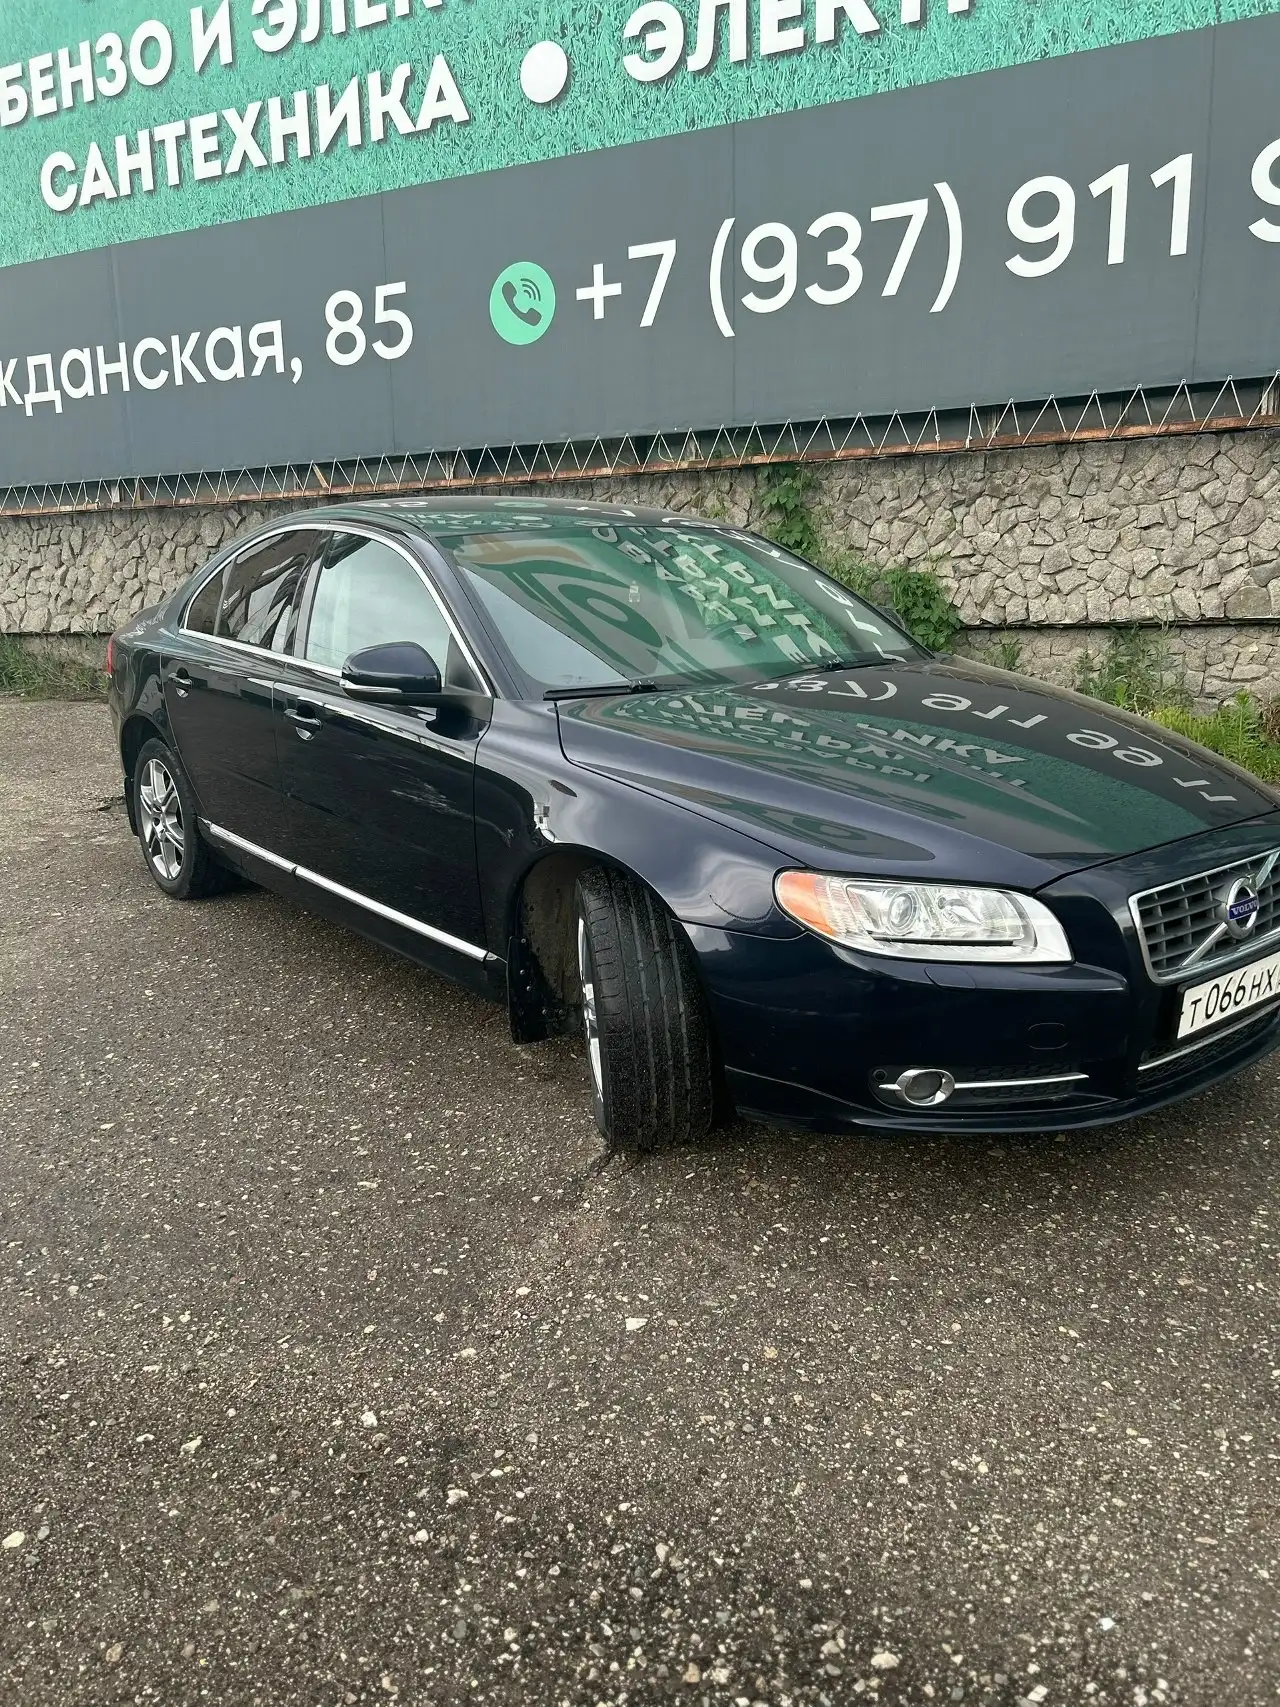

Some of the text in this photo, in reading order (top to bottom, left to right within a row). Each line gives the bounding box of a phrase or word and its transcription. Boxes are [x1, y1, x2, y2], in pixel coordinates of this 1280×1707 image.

[0, 19, 173, 127] БЕНЗО
[188, 0, 233, 73] И
[40, 53, 470, 212] САНТЕХНИКА
[576, 239, 678, 328] +7
[709, 182, 963, 337] (937)
[1005, 153, 1193, 278] 911
[324, 281, 414, 367] 85
[1230, 899, 1258, 916] VOLVO
